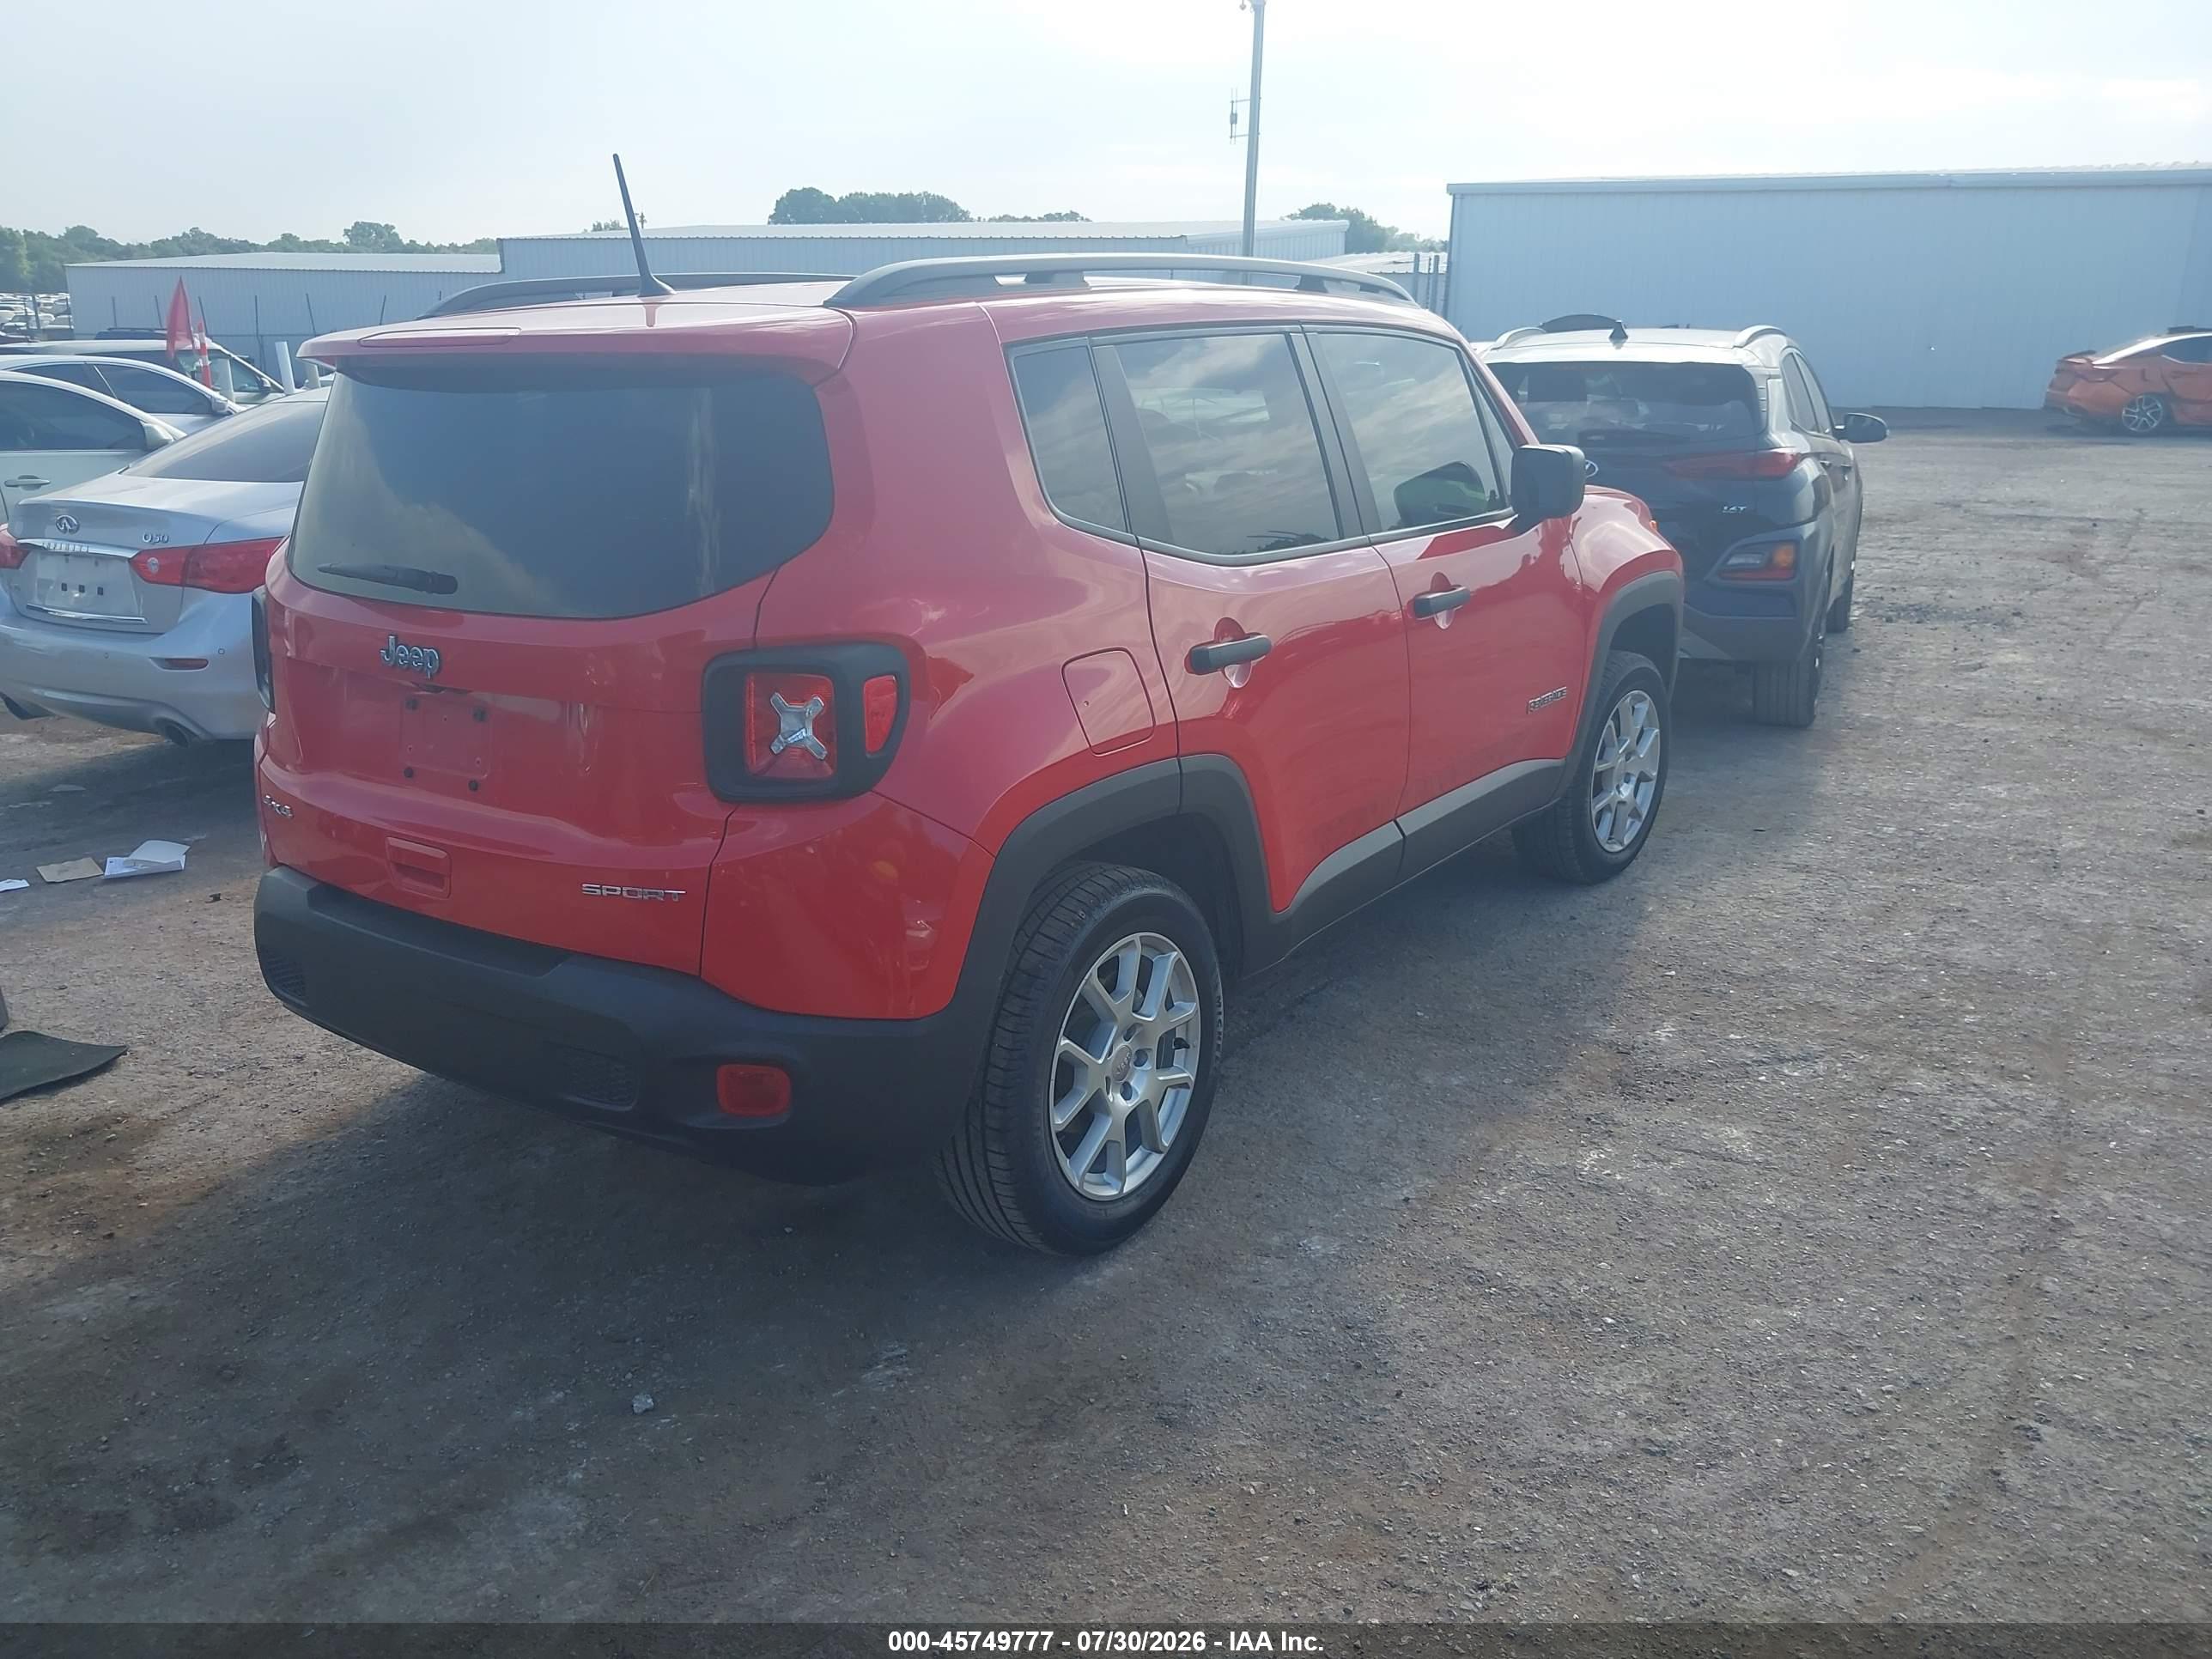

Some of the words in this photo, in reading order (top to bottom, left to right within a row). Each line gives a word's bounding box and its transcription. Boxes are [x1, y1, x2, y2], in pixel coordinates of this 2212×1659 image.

[142, 532, 170, 544] Q50
[380, 635, 440, 679] Jeep
[581, 883, 687, 902] SPORT
